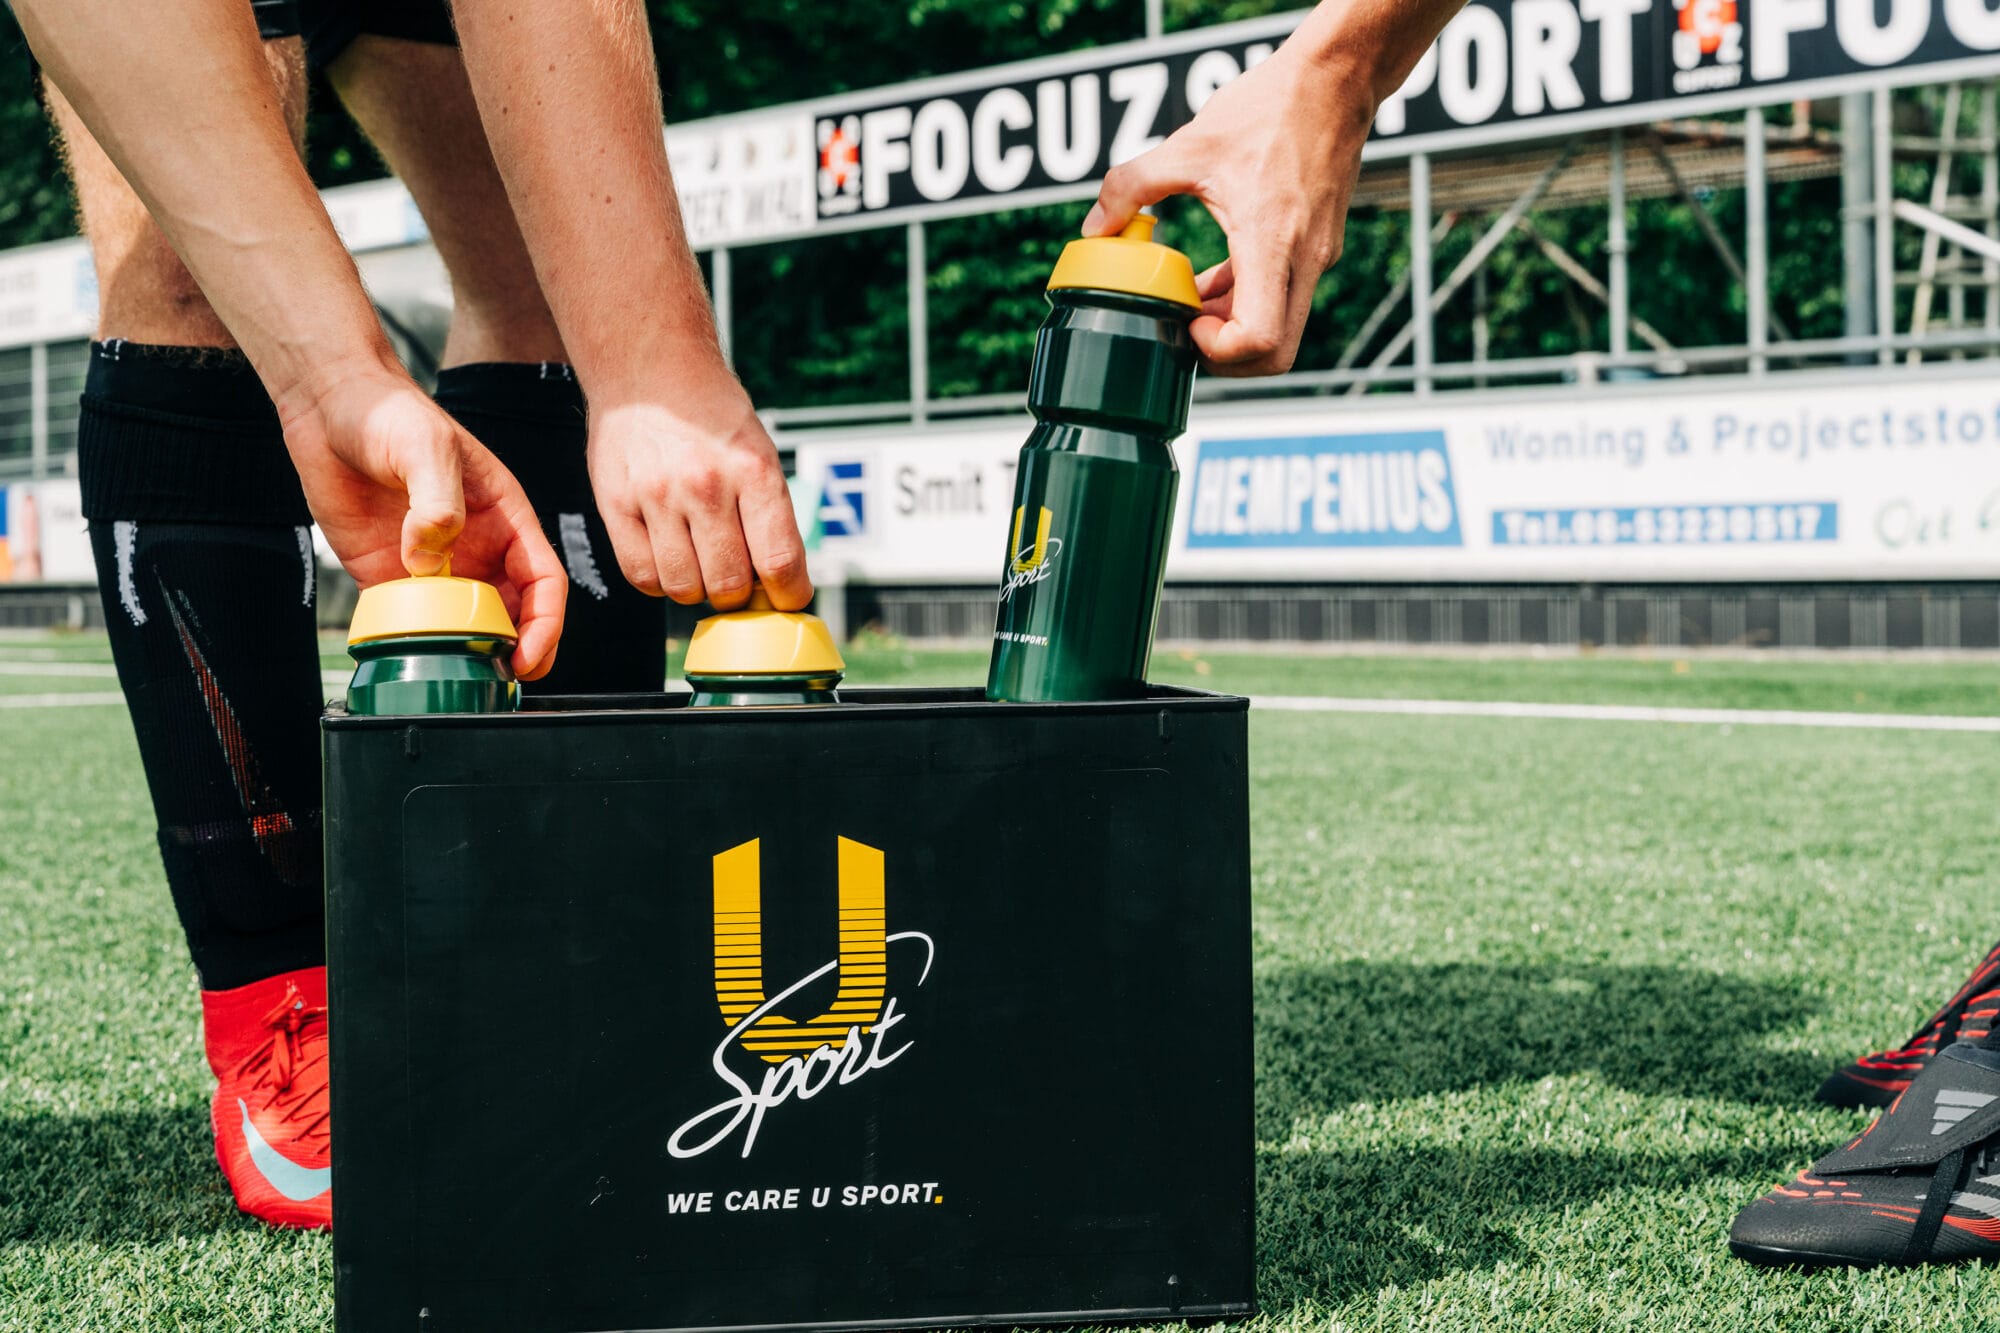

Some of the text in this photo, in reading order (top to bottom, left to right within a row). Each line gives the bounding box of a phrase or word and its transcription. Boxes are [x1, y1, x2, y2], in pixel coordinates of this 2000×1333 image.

[862, 63, 1169, 210] FOCUZ
[1486, 421, 1646, 466] Woning
[1665, 413, 1691, 456] &
[896, 463, 984, 516] Smit
[1192, 448, 1453, 536] HEMPENIUS
[1000, 538, 1063, 603] Sport
[1011, 504, 1053, 575] U
[712, 834, 887, 1063] U
[667, 931, 934, 1159] Sport
[667, 1182, 943, 1214] WE CARE U SPORT.
